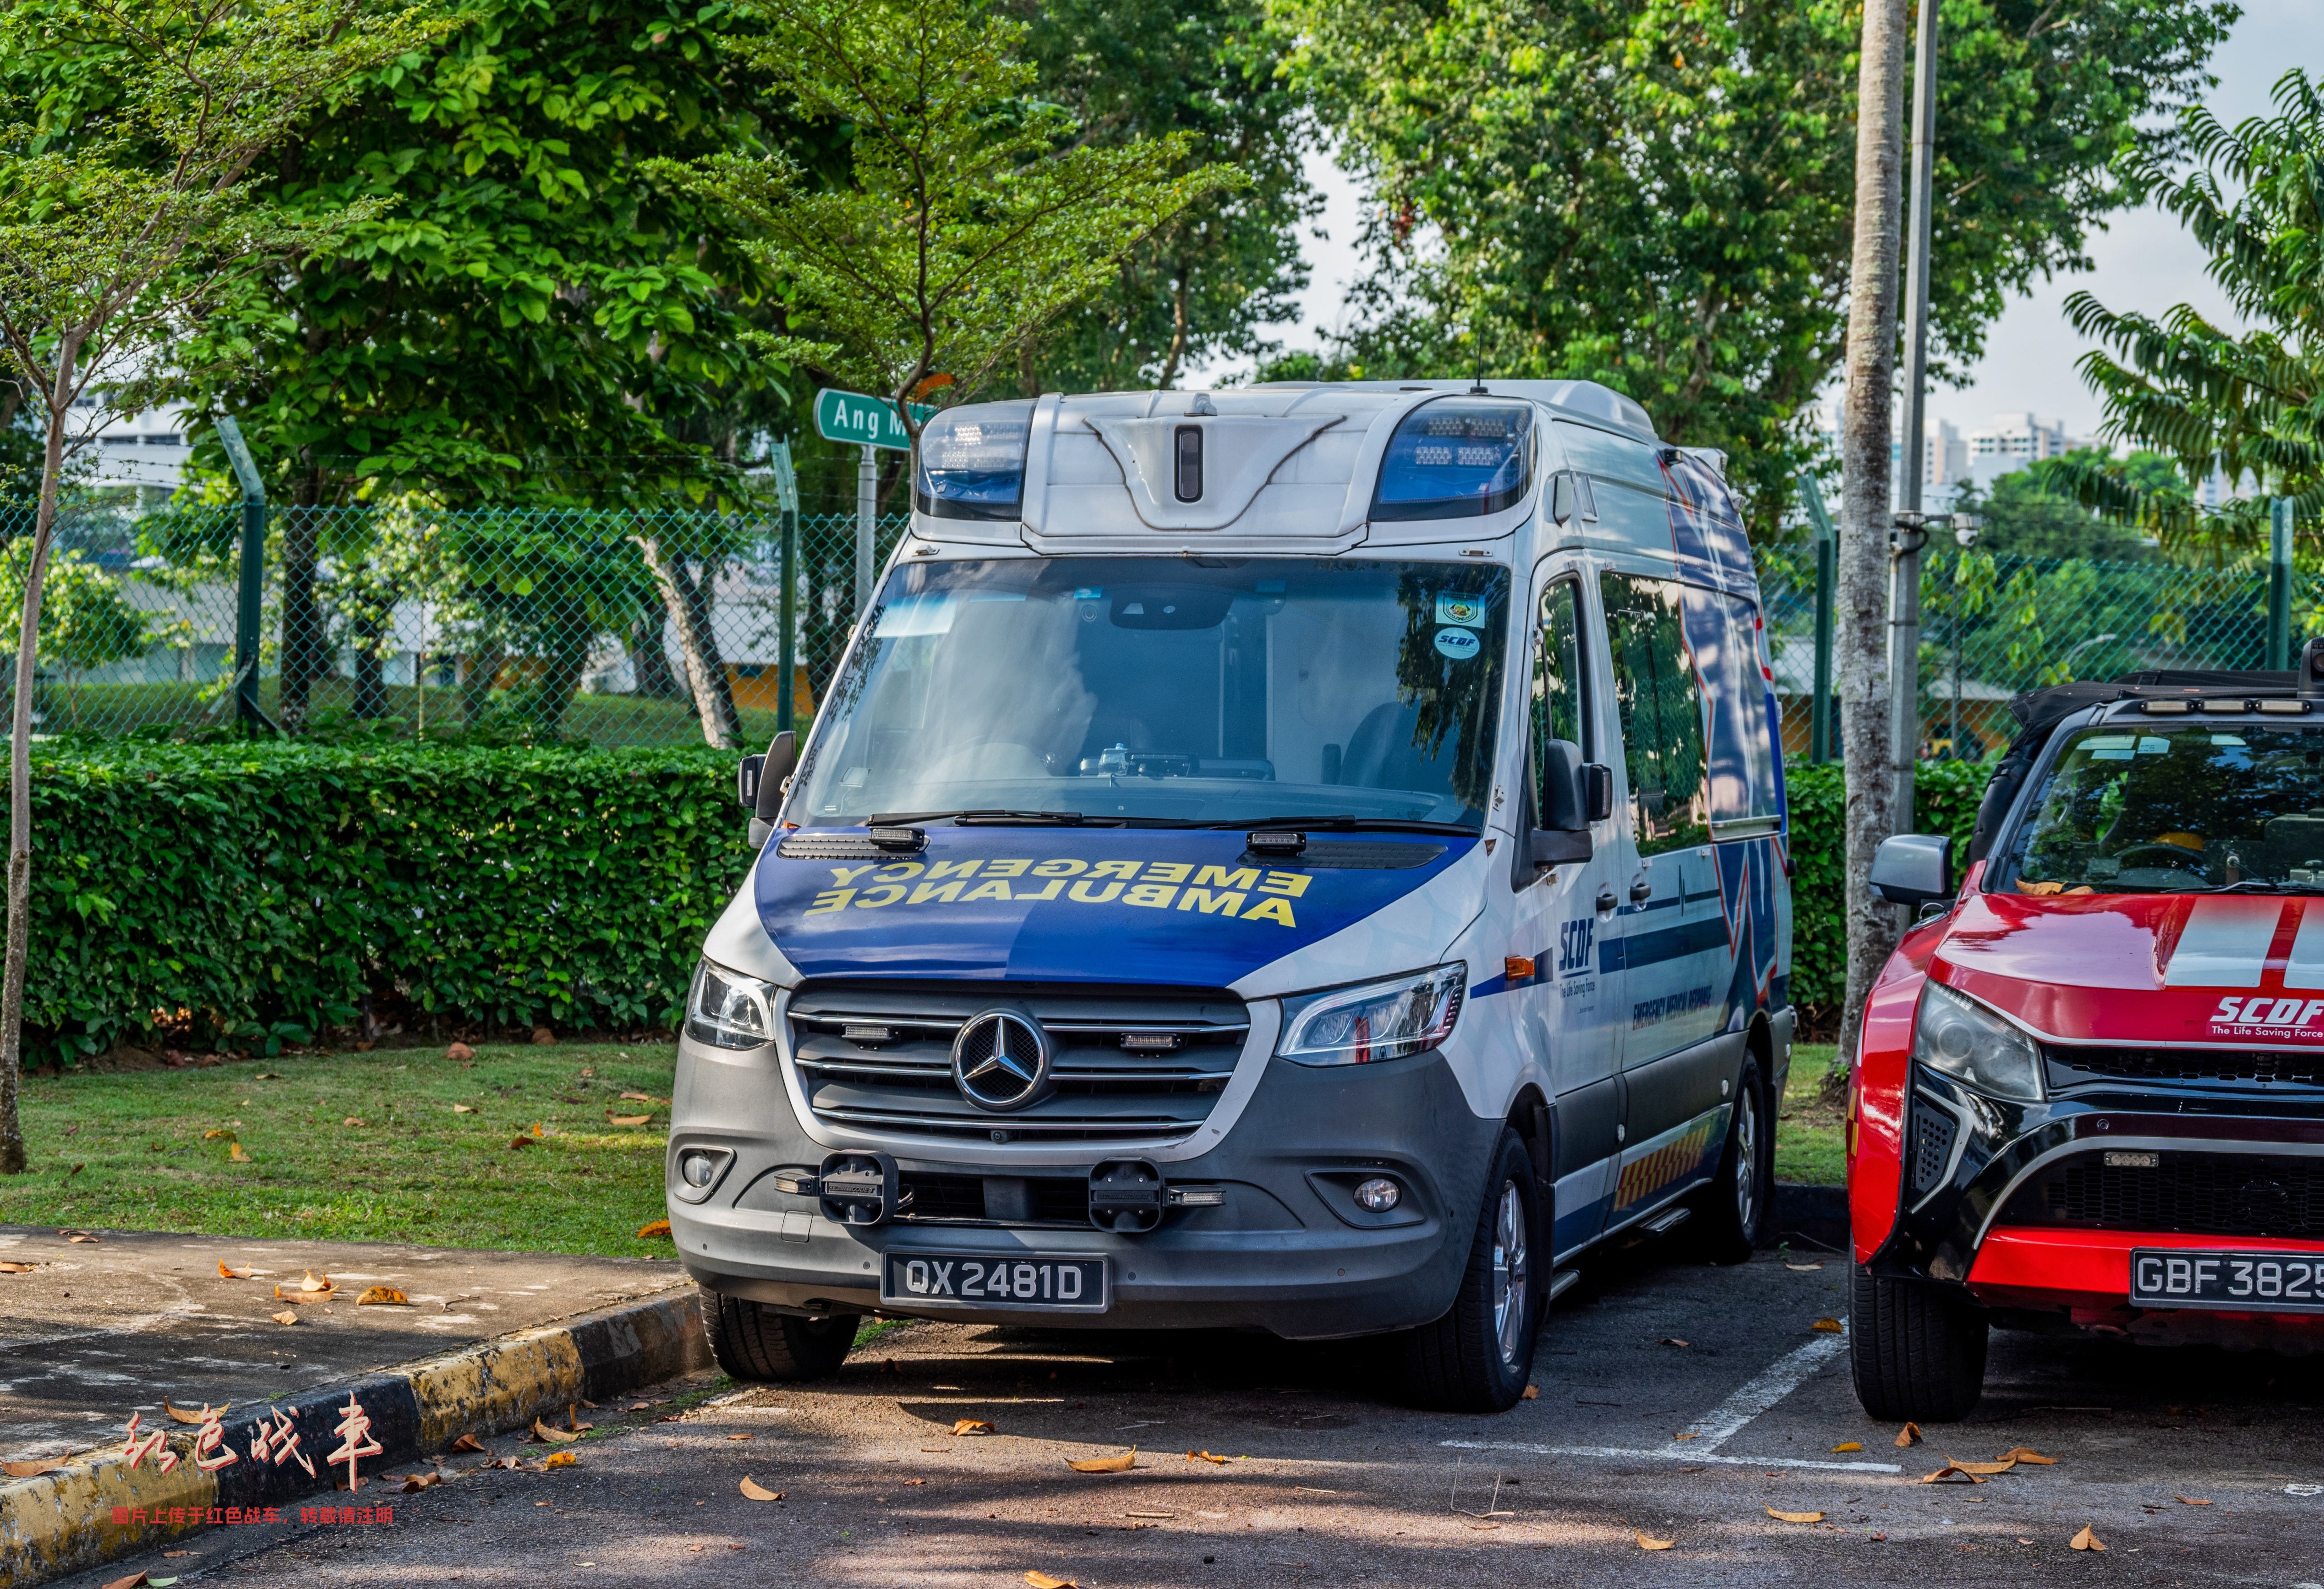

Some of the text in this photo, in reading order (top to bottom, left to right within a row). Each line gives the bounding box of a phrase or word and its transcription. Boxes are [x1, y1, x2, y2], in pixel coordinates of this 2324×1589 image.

[834, 399, 879, 439] Ang
[1438, 635, 1476, 646] SCDF
[1558, 917, 1594, 972] SCDF
[1632, 985, 1712, 1031] EMERGENCY MEDICAL RESPONSE
[2209, 996, 2324, 1025] SCDF
[2212, 1026, 2324, 1038] The Life Saving Force
